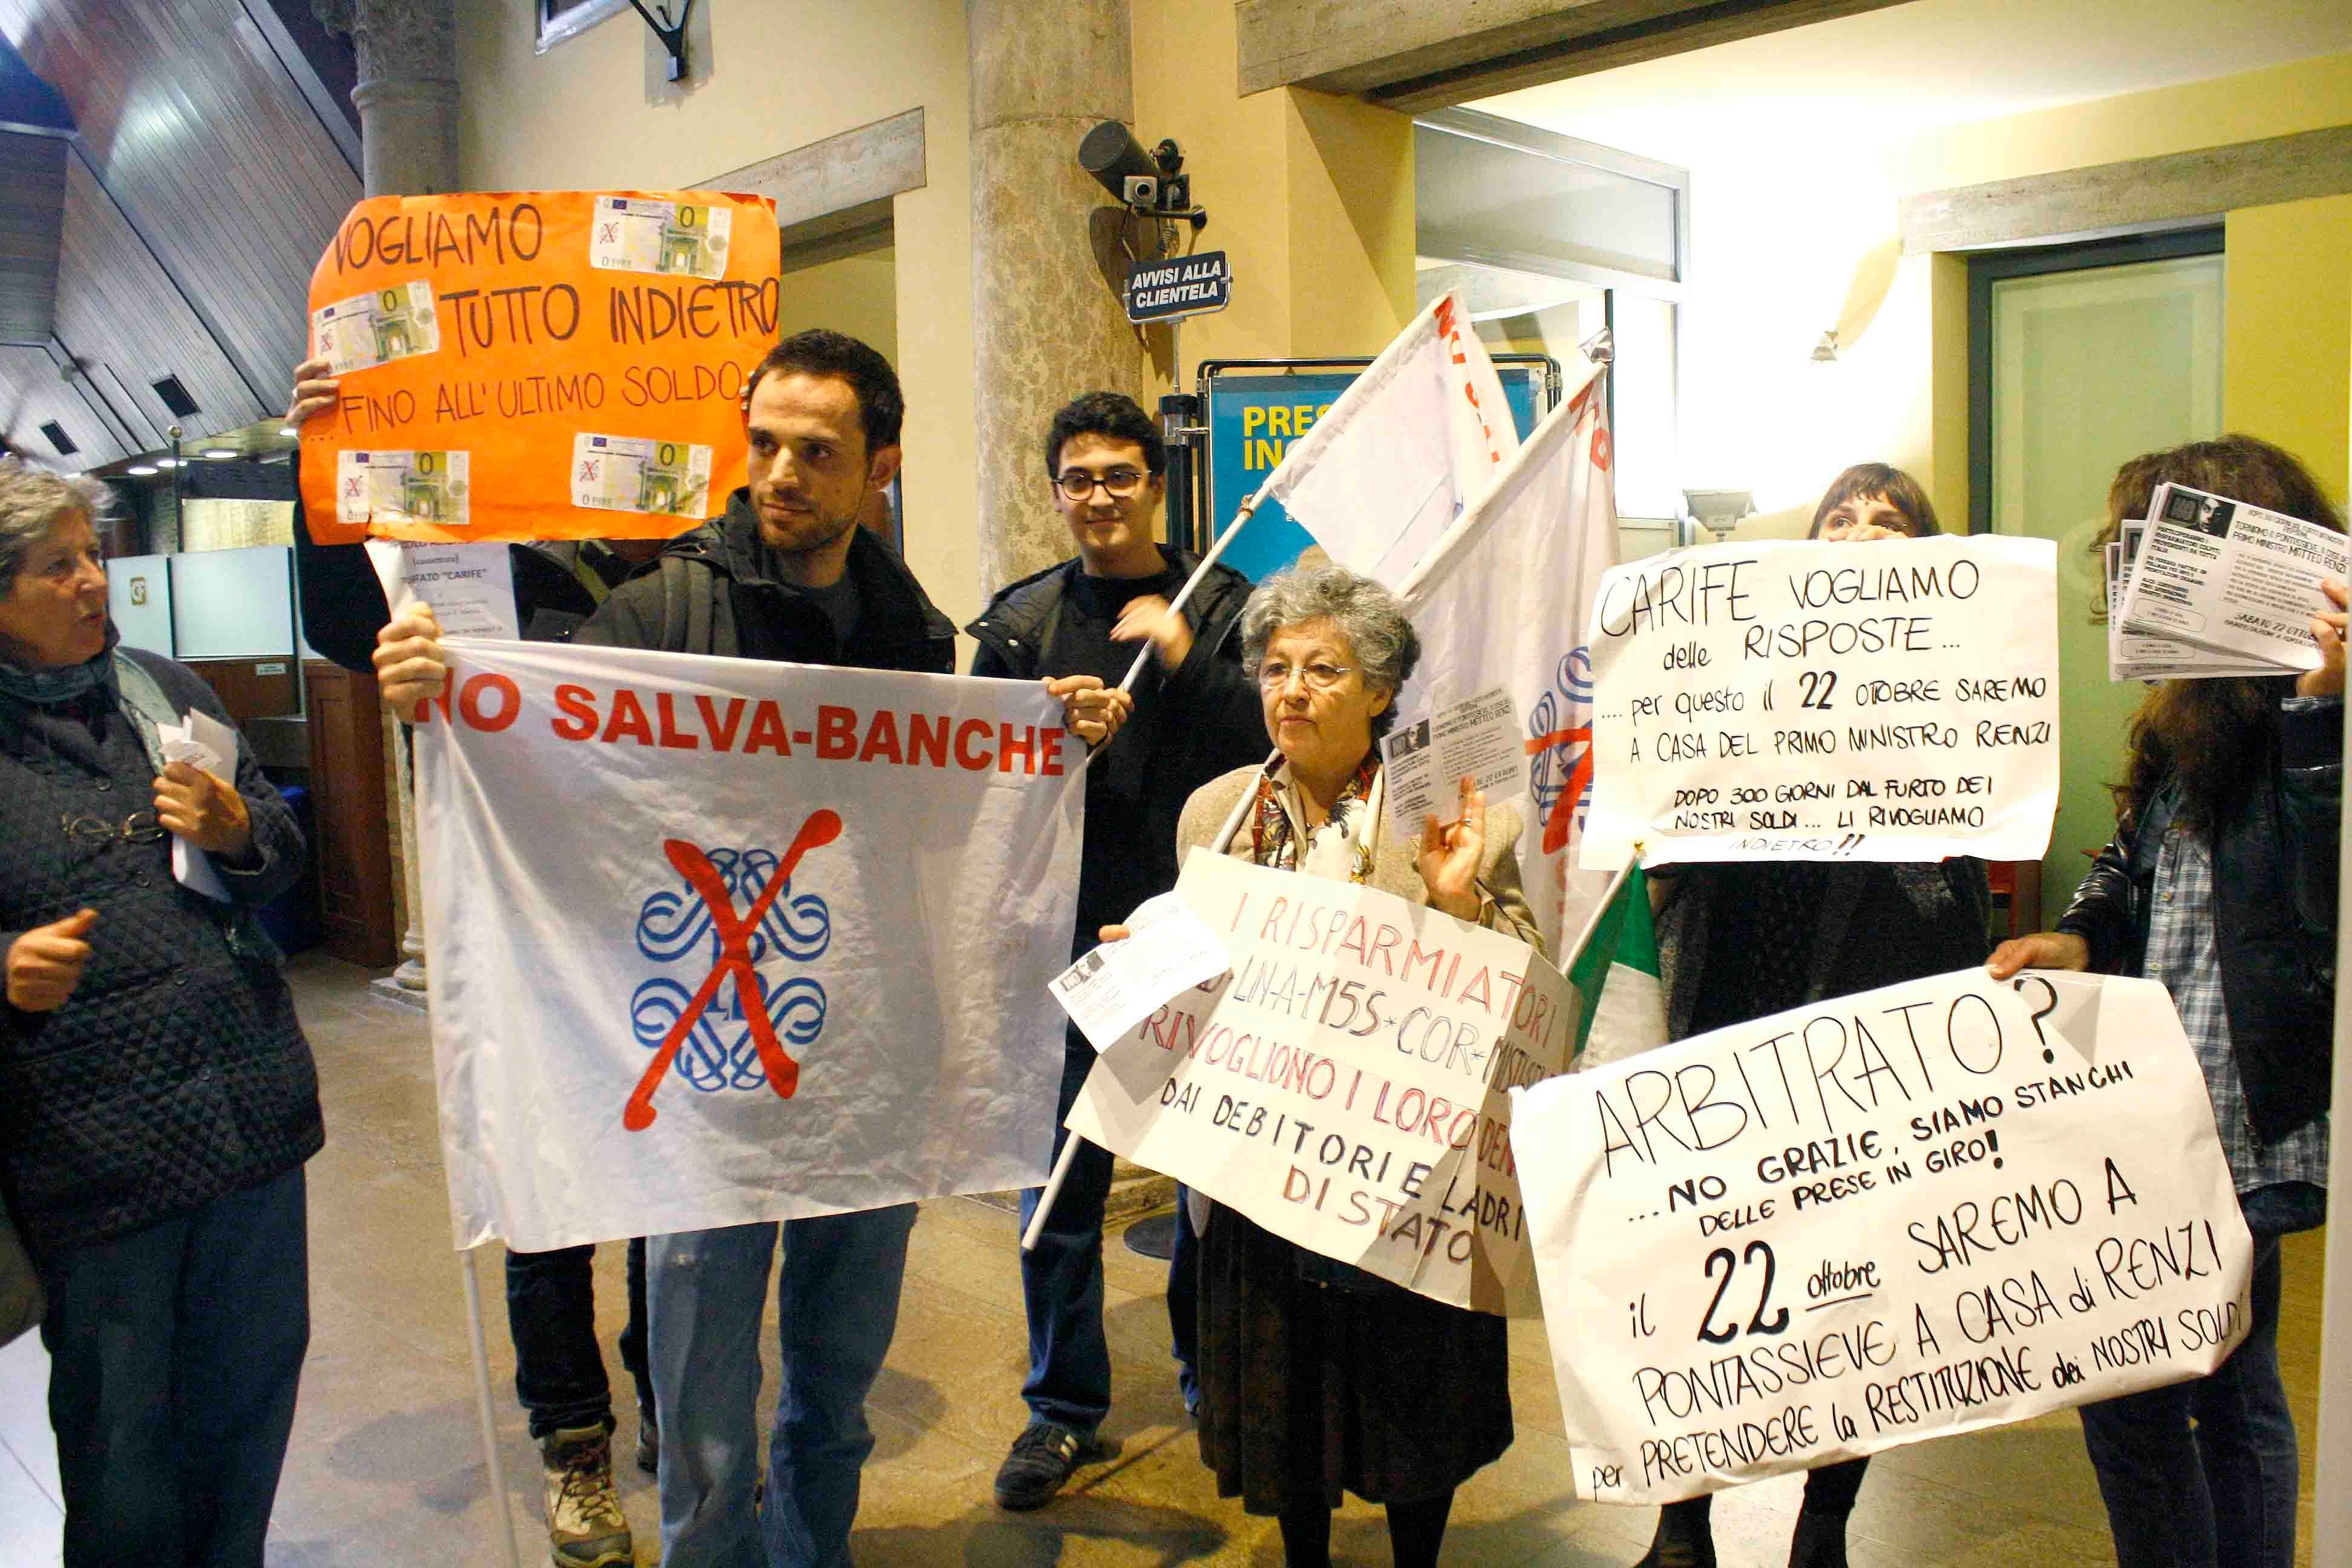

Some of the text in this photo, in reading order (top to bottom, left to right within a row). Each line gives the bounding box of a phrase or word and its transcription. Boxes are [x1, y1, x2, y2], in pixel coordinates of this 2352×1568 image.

[335, 203, 543, 276] VOGLIAMO
[1132, 261, 1221, 290] AVVISI ALLA
[439, 276, 779, 357] TUTTO INDIETRO
[1136, 281, 1218, 308] CLIENTELA
[436, 372, 604, 423] ALL'ULTIMO
[622, 360, 742, 407] SOLDO
[1601, 560, 1979, 638] CARIFE VOGLIAMO
[1664, 641, 1712, 670] delle
[550, 684, 1065, 776] SALVA-BANCHE
[1675, 687, 1745, 723] questo
[1763, 680, 1772, 711] il
[1799, 671, 1837, 710] 22
[1955, 676, 2046, 702] SAREMO
[1631, 721, 2050, 763] A CASA DEL PRIMO MINISTRO RENZI
[1674, 776, 1991, 807] DOPO 300 GIORNI DAL FURTO DEI
[1675, 811, 1735, 829] NOSTRI
[1838, 810, 1854, 828] LI
[1869, 806, 1984, 827] RIVOGLIAMO
[1230, 893, 1557, 1049] I RISPARMIATORI
[1346, 1071, 1361, 1109] I
[1373, 1080, 1479, 1150] LORO
[1912, 1096, 2004, 1143] SIAMO
[2017, 1060, 2134, 1110] STANCHI
[1161, 1077, 1523, 1242] DAI DEBITORI E LADRI
[1283, 1165, 1472, 1263] DI STATO
[1700, 1199, 1775, 1237] DELLE
[1794, 1171, 1876, 1211] PRESE
[1886, 1162, 1913, 1186] IN
[1632, 1158, 2137, 1345] il 22 ottobre SAREMO A
[1632, 1218, 2220, 1428] PONTASSIEVE A CASA di RENZI
[1592, 1463, 1624, 1502] per
[1641, 1406, 1818, 1488] PRETENDERE
[1833, 1403, 1857, 1442] la
[1866, 1347, 2041, 1432] RESTITUZIONE
[2052, 1354, 2085, 1391] dei
[2092, 1316, 2170, 1375] NOSTRI
